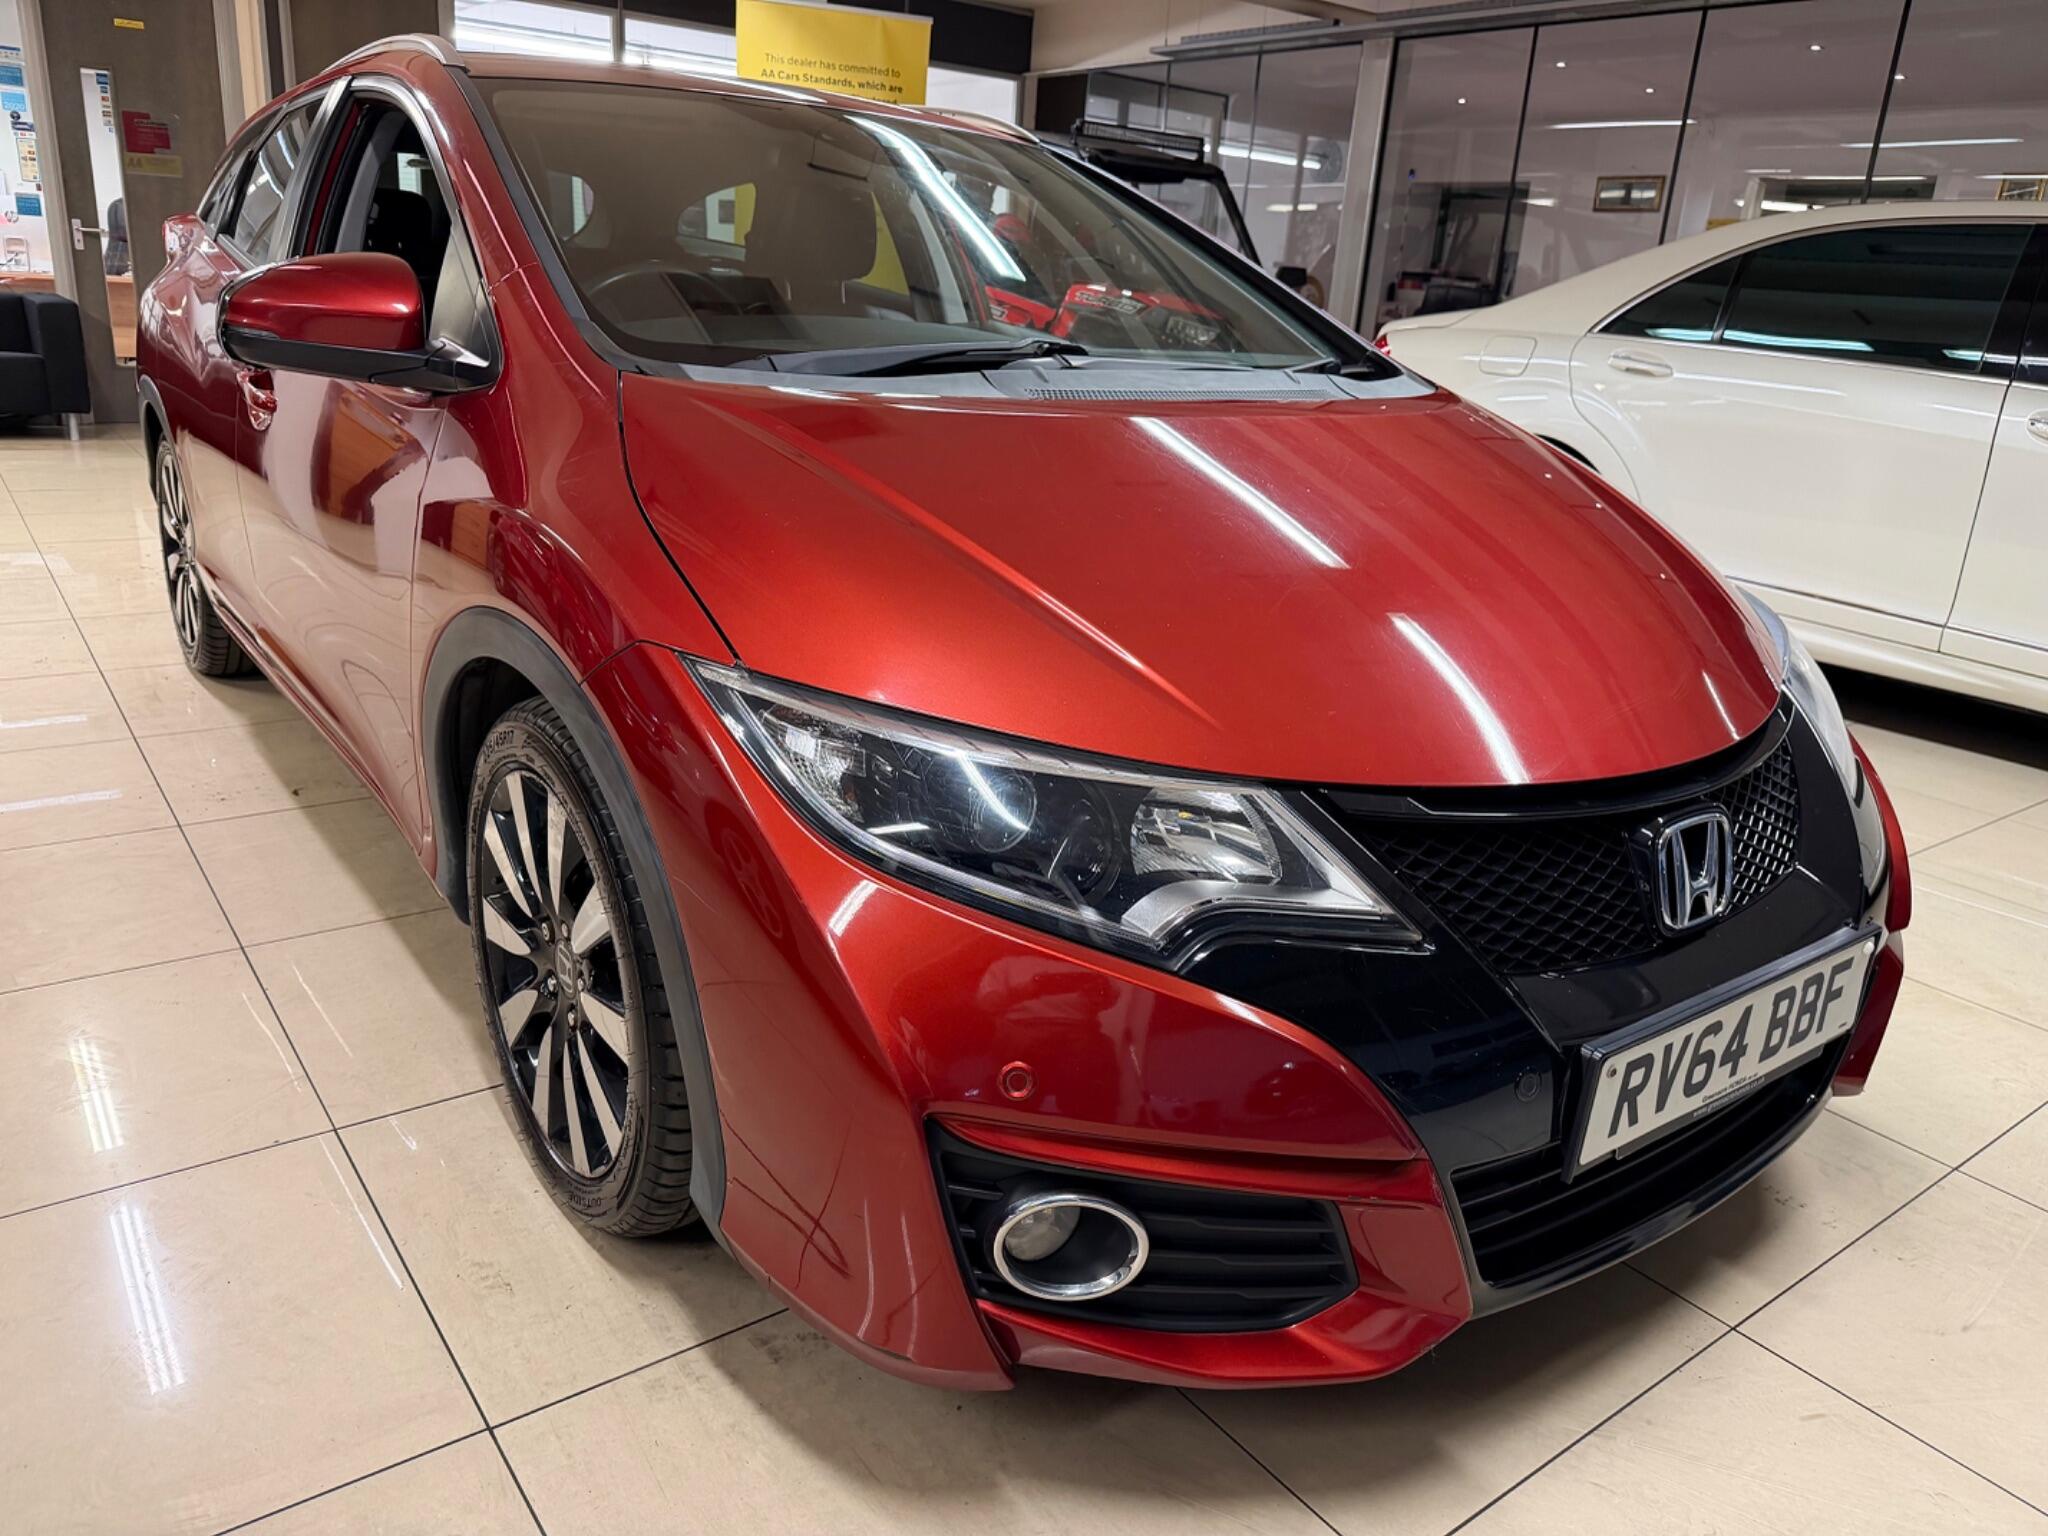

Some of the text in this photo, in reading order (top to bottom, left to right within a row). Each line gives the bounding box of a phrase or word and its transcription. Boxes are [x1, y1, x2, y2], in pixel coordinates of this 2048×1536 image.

[765, 52, 902, 78] This dealer has committed to
[761, 68, 903, 93] AA Cars Standards, which are
[1608, 956, 1855, 1138] RV64 BBF
